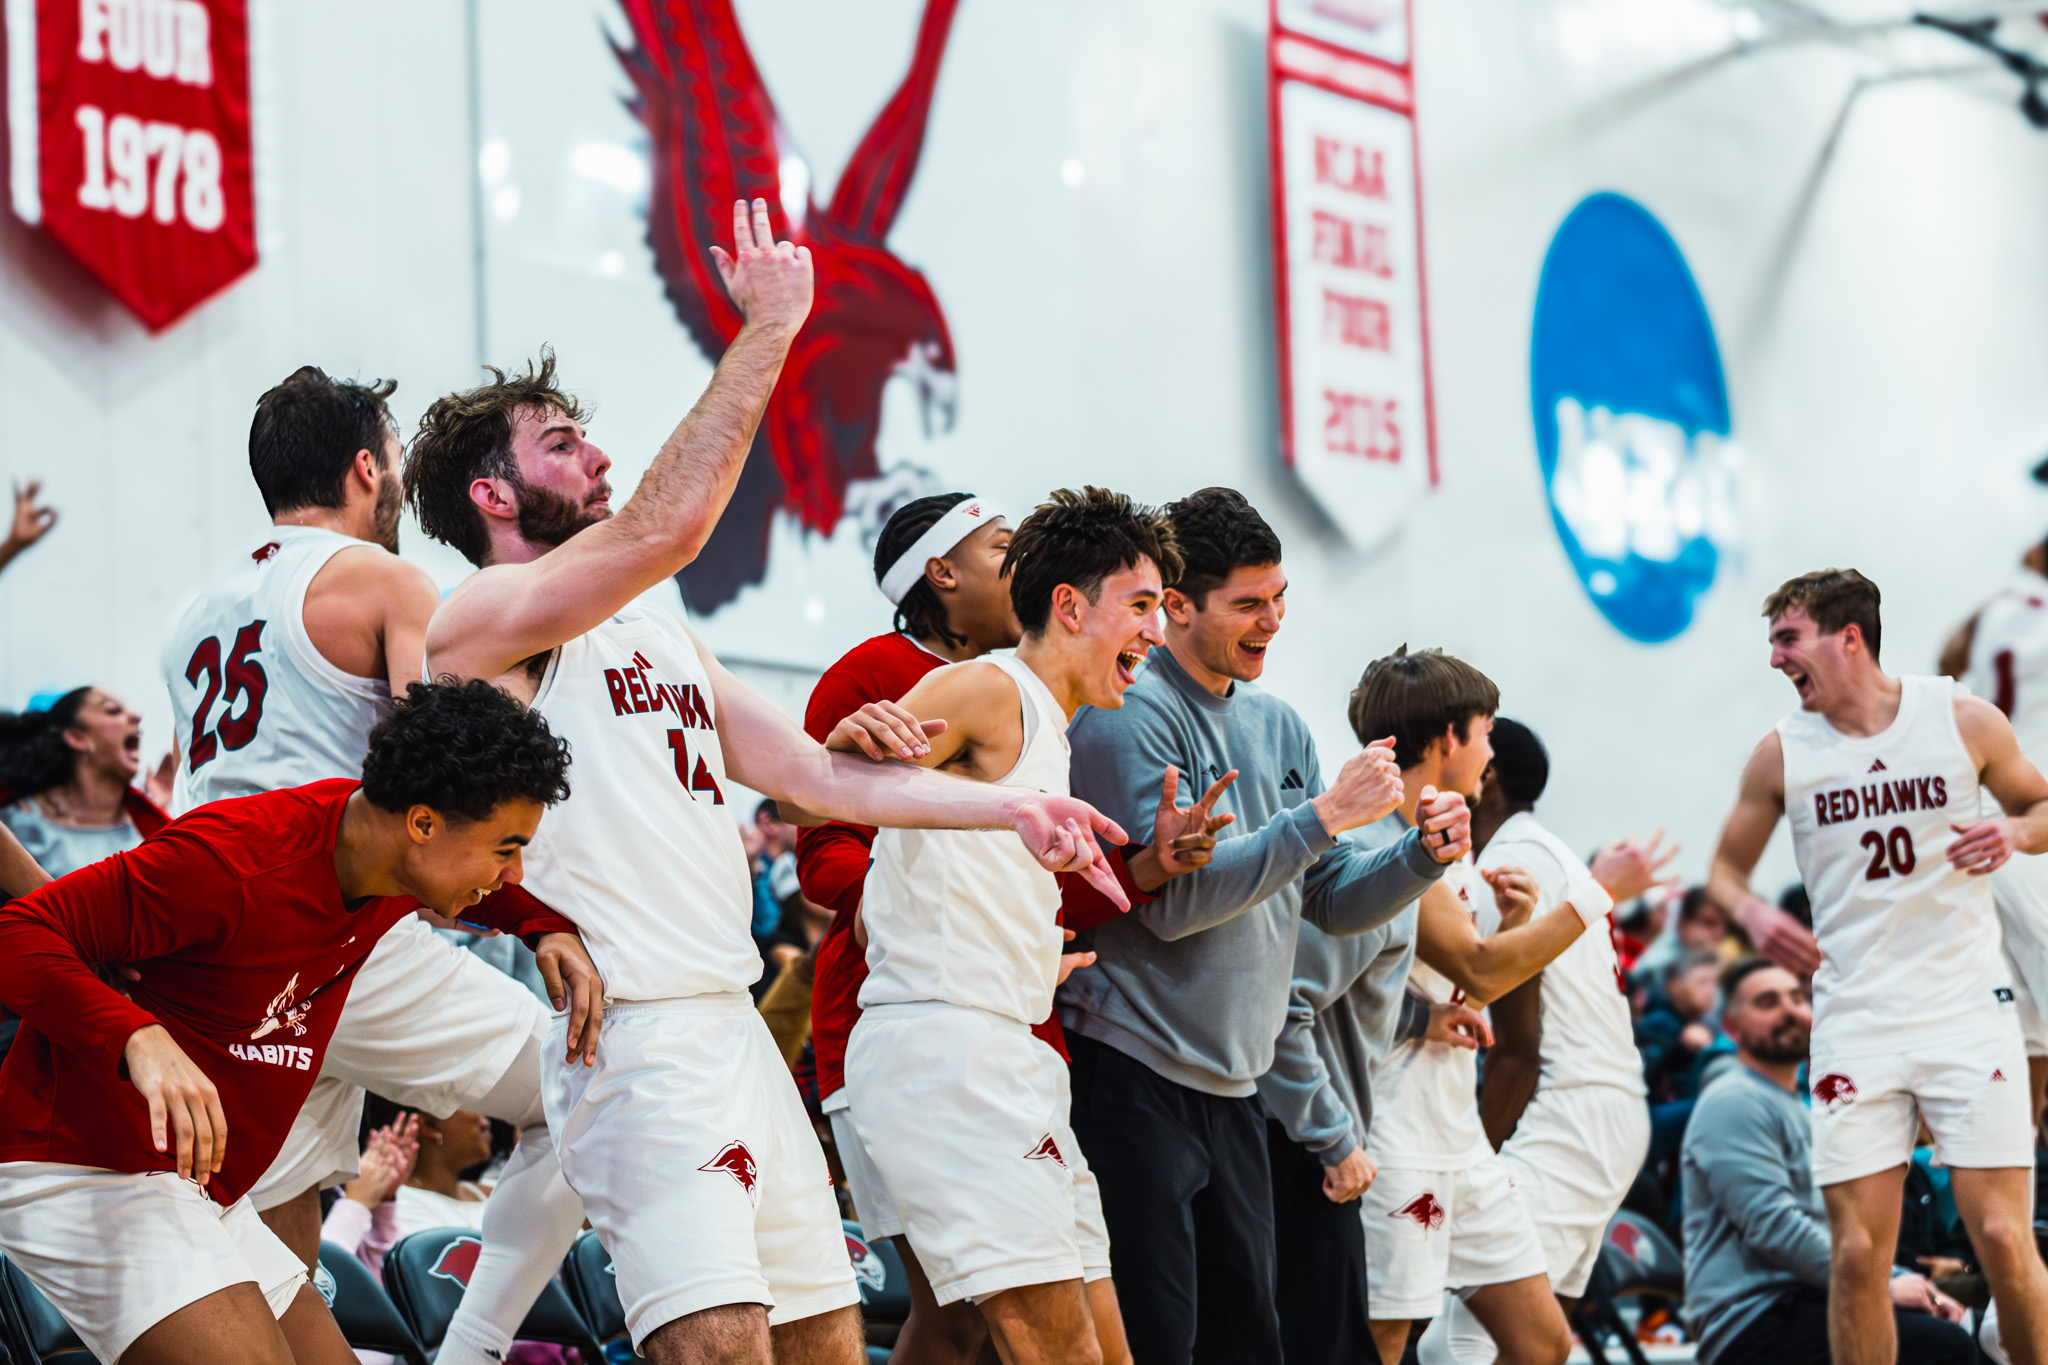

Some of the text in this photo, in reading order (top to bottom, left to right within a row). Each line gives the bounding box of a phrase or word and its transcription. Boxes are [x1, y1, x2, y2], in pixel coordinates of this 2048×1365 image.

[78, 0, 213, 88] FOUR
[75, 104, 225, 232] 1978
[185, 619, 268, 775] 25
[667, 729, 725, 805] 14
[1859, 825, 1916, 881] 20
[229, 1044, 313, 1071] HABITS
